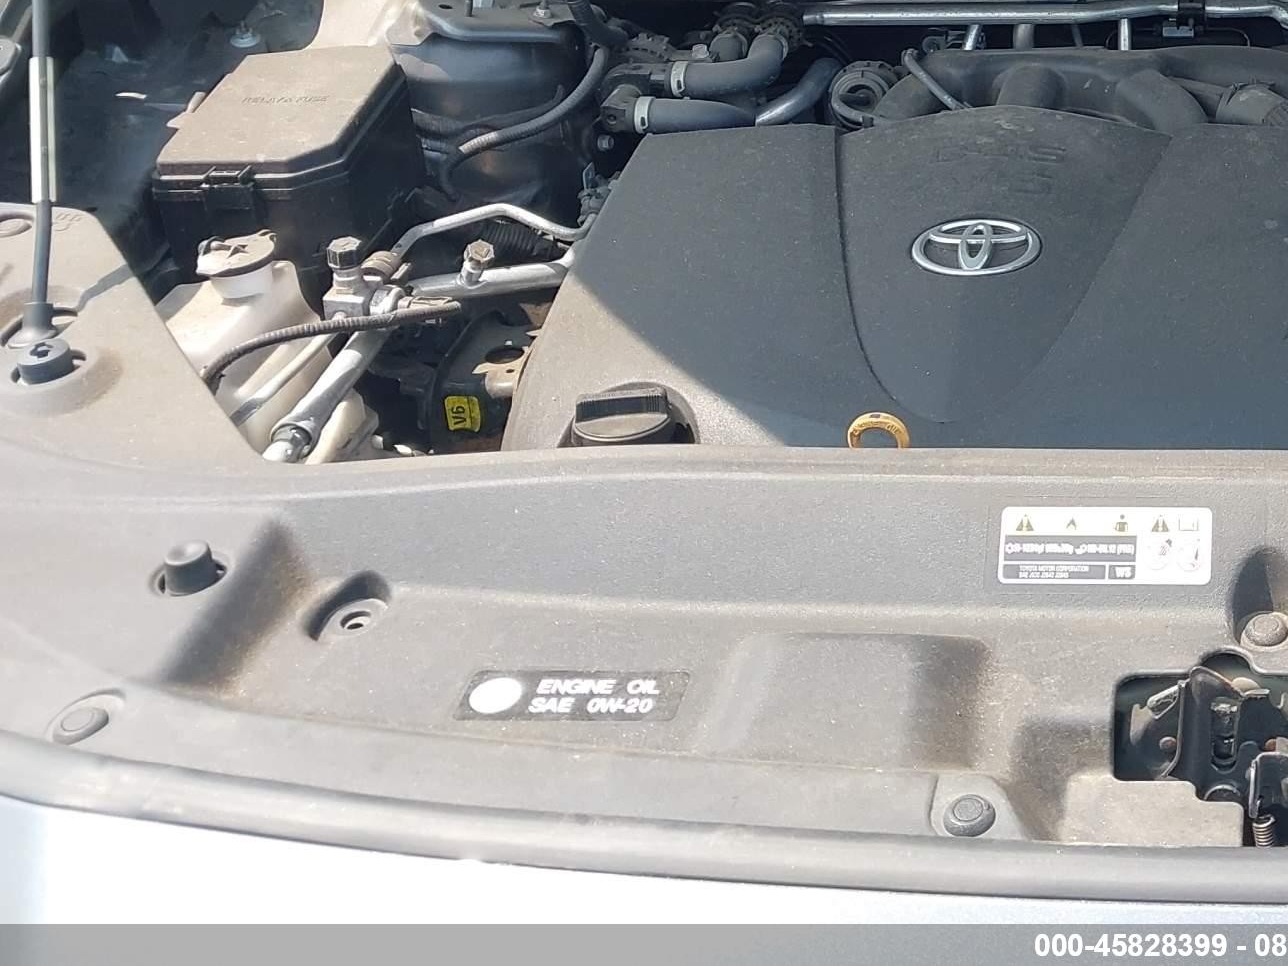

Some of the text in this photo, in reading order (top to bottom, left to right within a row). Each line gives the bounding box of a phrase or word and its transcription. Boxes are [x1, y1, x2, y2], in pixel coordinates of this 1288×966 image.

[451, 405, 466, 425] V6
[536, 679, 660, 694] ENGINE OIL
[528, 697, 654, 714] SAE 0W-20
